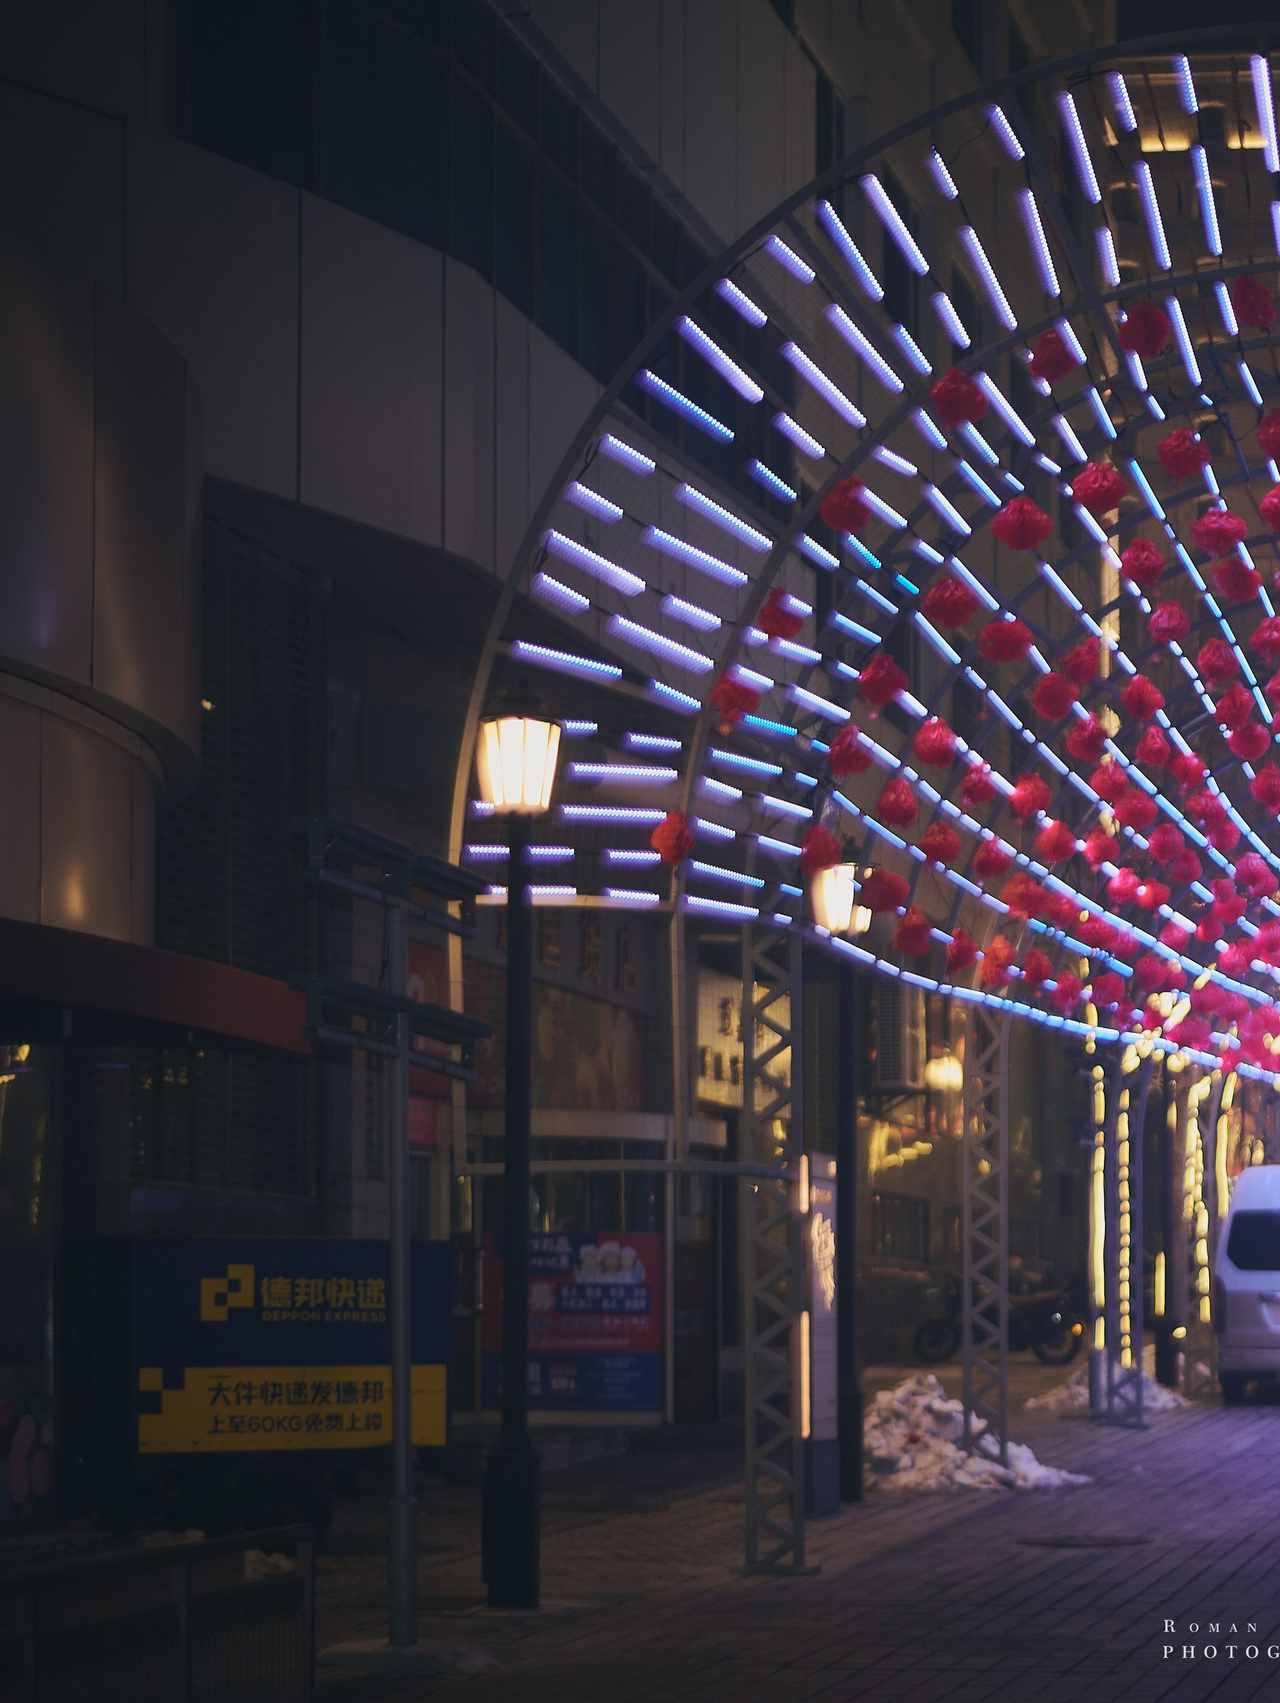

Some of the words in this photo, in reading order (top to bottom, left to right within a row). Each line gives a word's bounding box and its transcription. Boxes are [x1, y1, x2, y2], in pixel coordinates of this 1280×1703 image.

[260, 1276, 387, 1309] 德邦快递
[261, 1310, 320, 1322] DEPPON
[325, 1310, 387, 1322] EXPRESS
[207, 1380, 384, 1406] 大件快递发德邦
[207, 1413, 383, 1434] 上至60KG免费上楼
